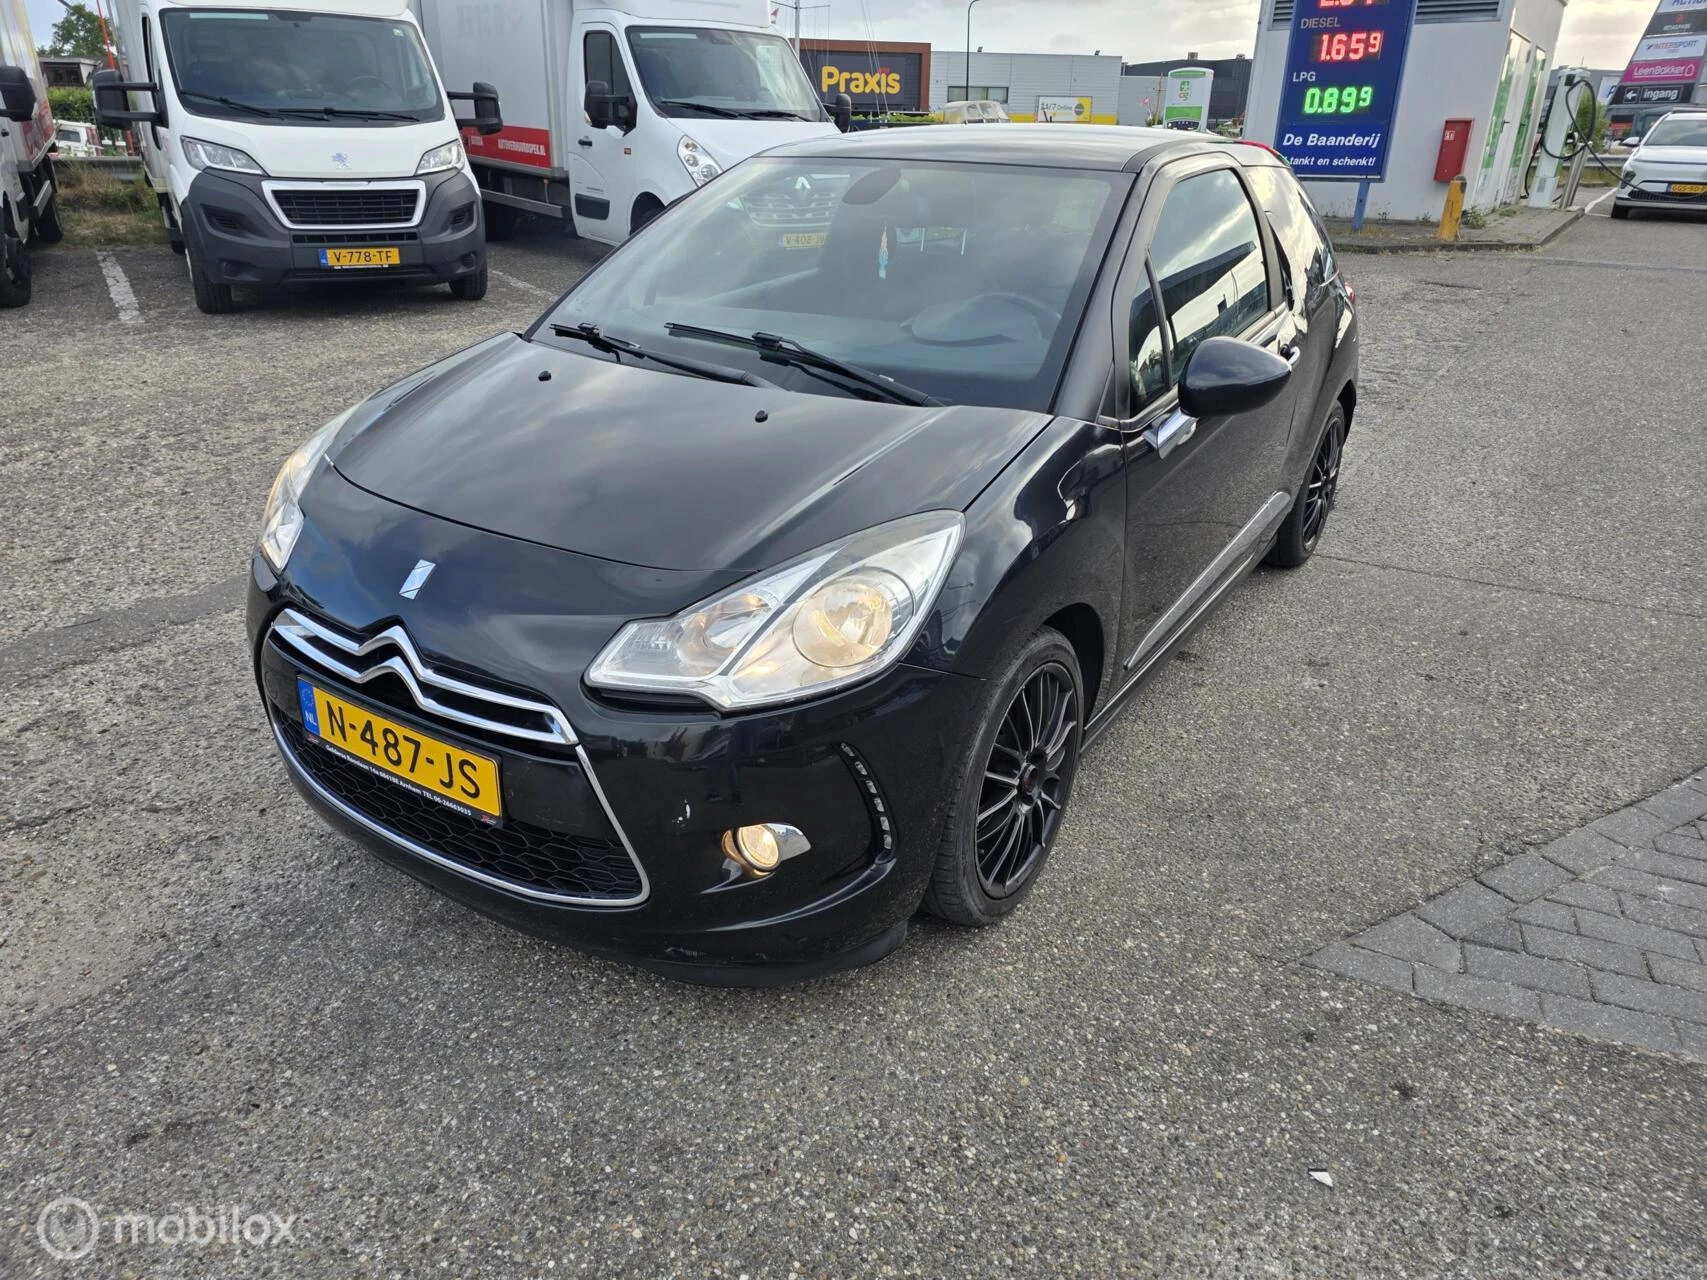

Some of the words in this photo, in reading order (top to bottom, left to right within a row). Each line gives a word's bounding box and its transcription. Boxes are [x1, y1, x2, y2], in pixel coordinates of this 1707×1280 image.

[1300, 17, 1341, 29] DIESEL
[1292, 71, 1317, 82] LPG
[1633, 65, 1685, 76] LeenBakker
[821, 65, 901, 95] Praxis
[1643, 88, 1679, 100] ingang
[1283, 133, 1303, 146] De
[1306, 133, 1381, 149] Baanderij
[1290, 156, 1315, 166] tankt
[1317, 157, 1330, 166] en
[1332, 156, 1376, 166] schenkt!
[333, 250, 392, 263] V-778-TF
[305, 710, 318, 726] NL
[327, 700, 480, 799] N-487-JS
